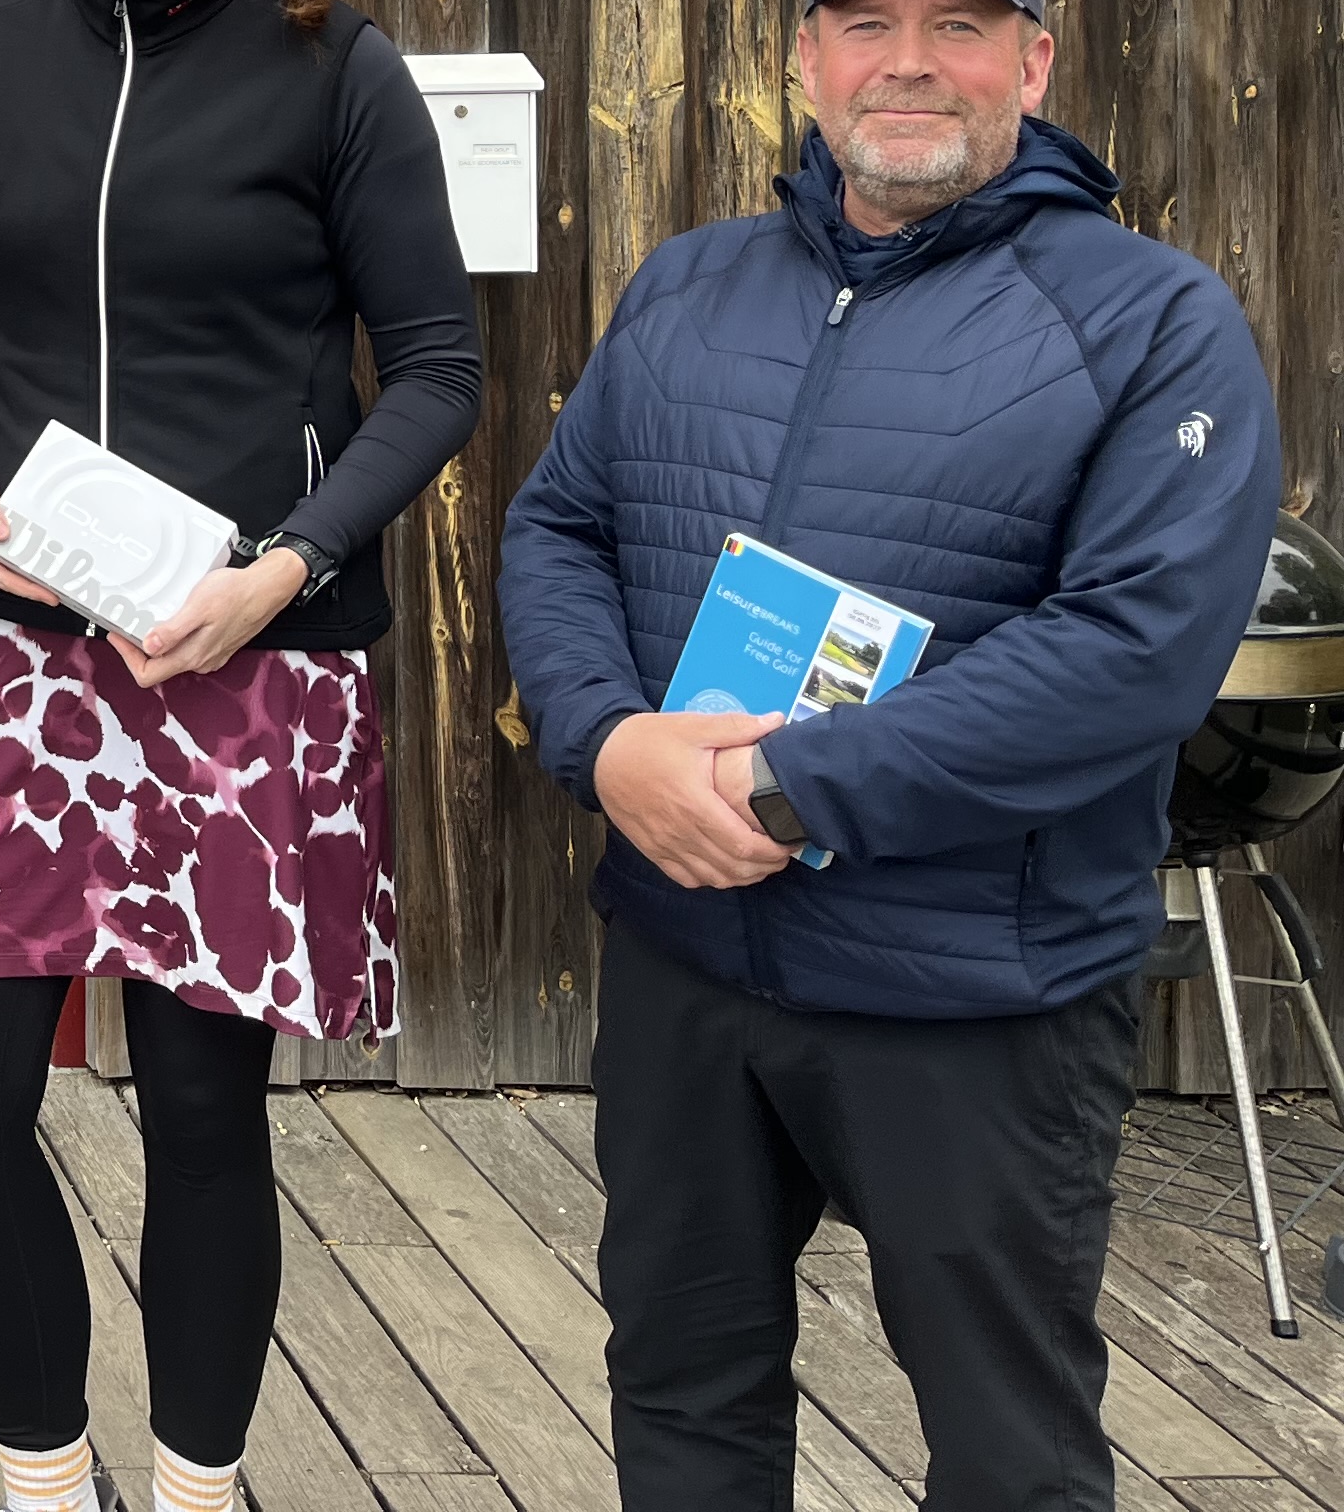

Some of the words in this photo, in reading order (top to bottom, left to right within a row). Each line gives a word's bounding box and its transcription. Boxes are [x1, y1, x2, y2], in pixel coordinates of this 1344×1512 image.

[743, 643, 770, 665] Free
[772, 658, 800, 678] Golf
[748, 631, 783, 656] Guide
[784, 649, 805, 666] for
